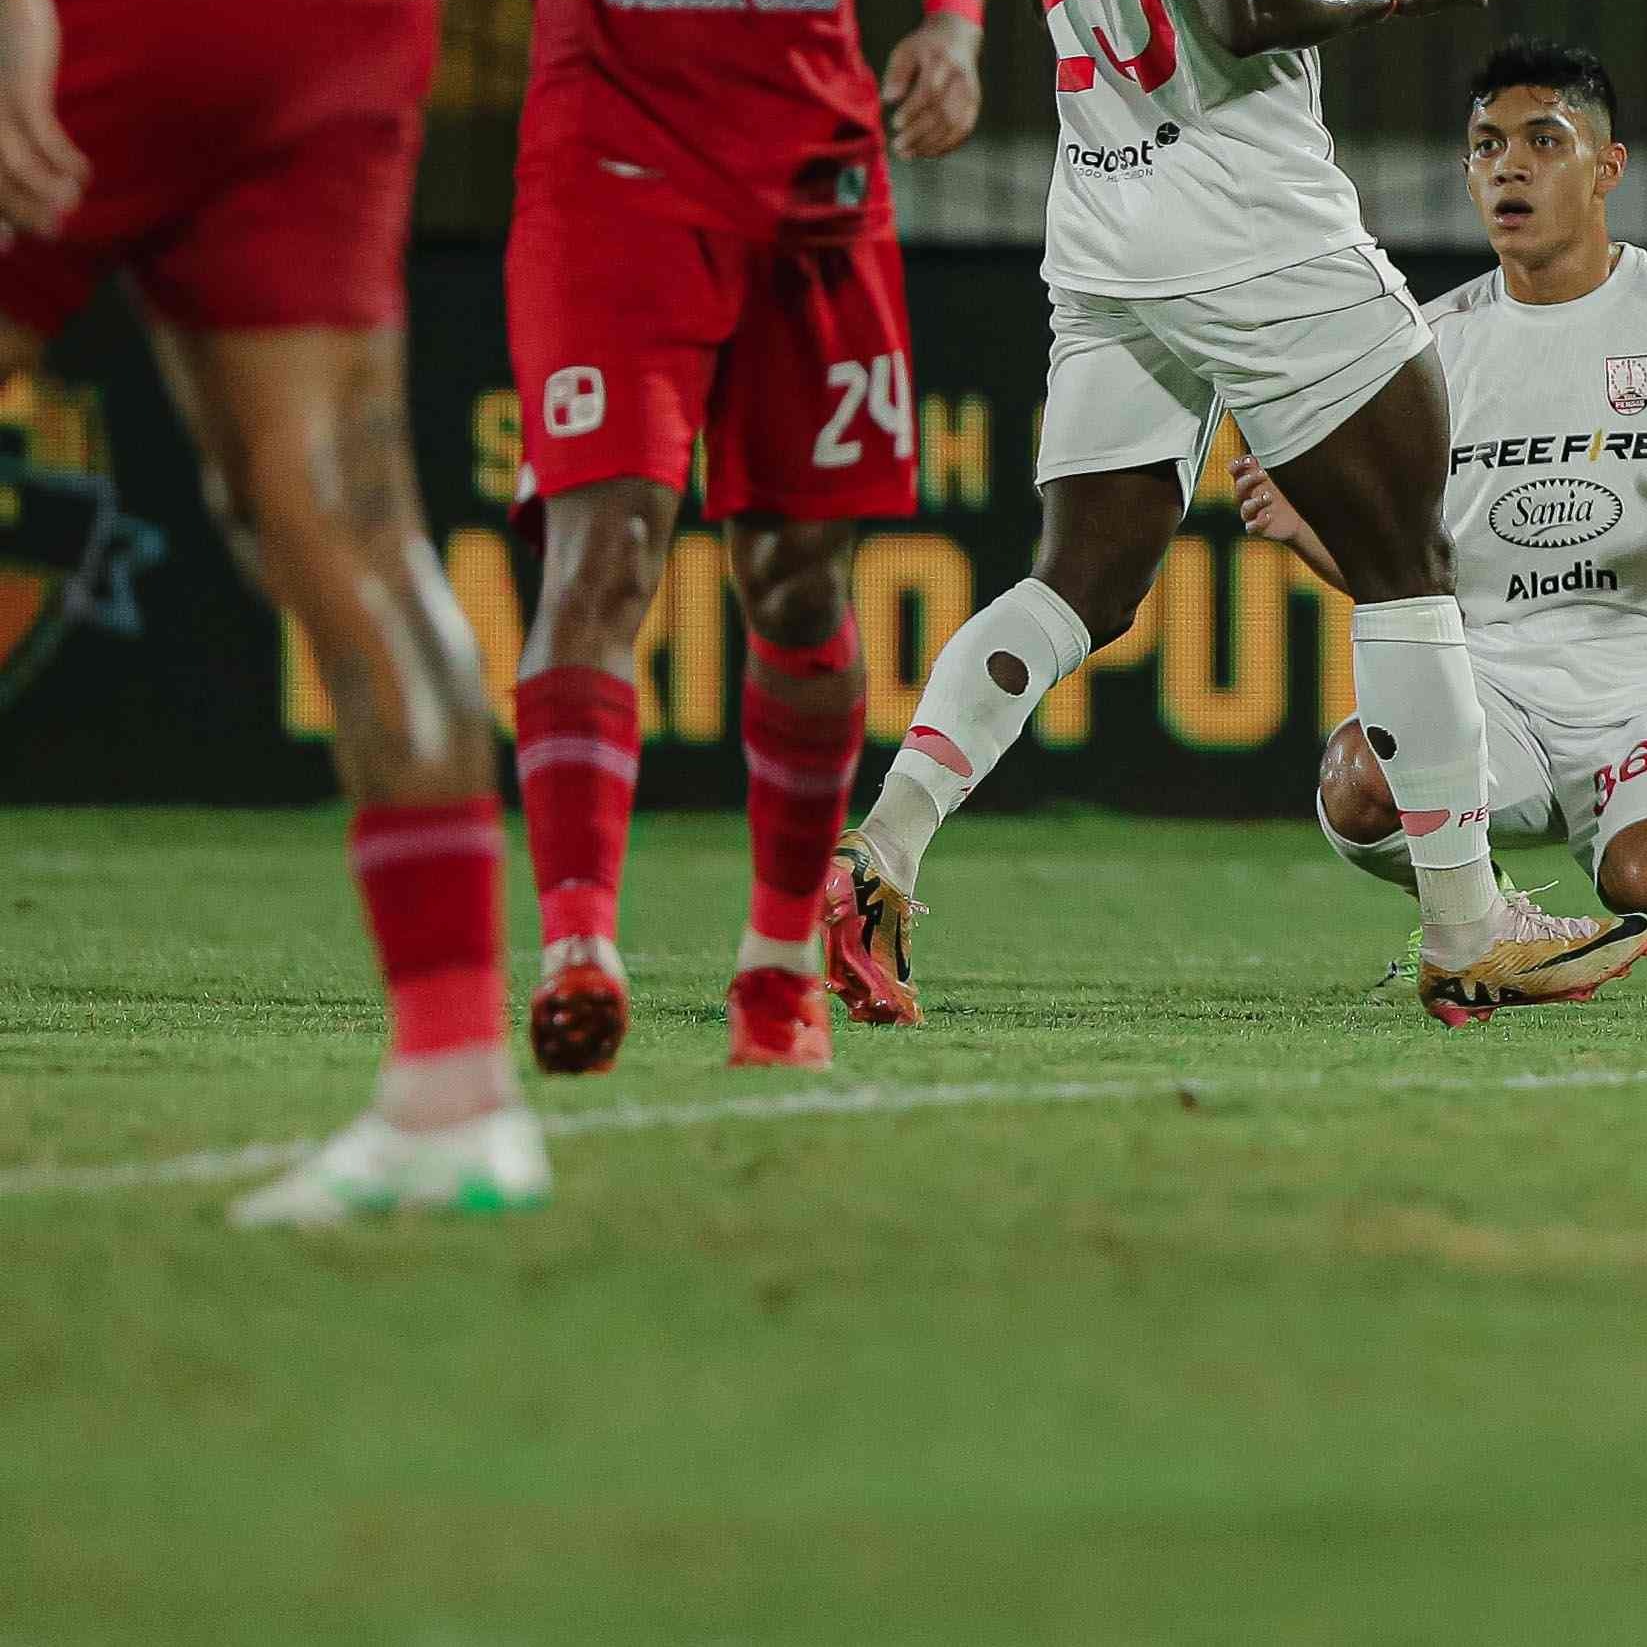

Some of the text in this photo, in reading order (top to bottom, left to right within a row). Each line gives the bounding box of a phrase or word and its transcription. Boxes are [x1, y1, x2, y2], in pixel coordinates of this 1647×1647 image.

[812, 349, 914, 468] 24
[1450, 440, 1556, 476] FREE
[1511, 490, 1594, 528] Sania
[1505, 560, 1618, 602] Aladin
